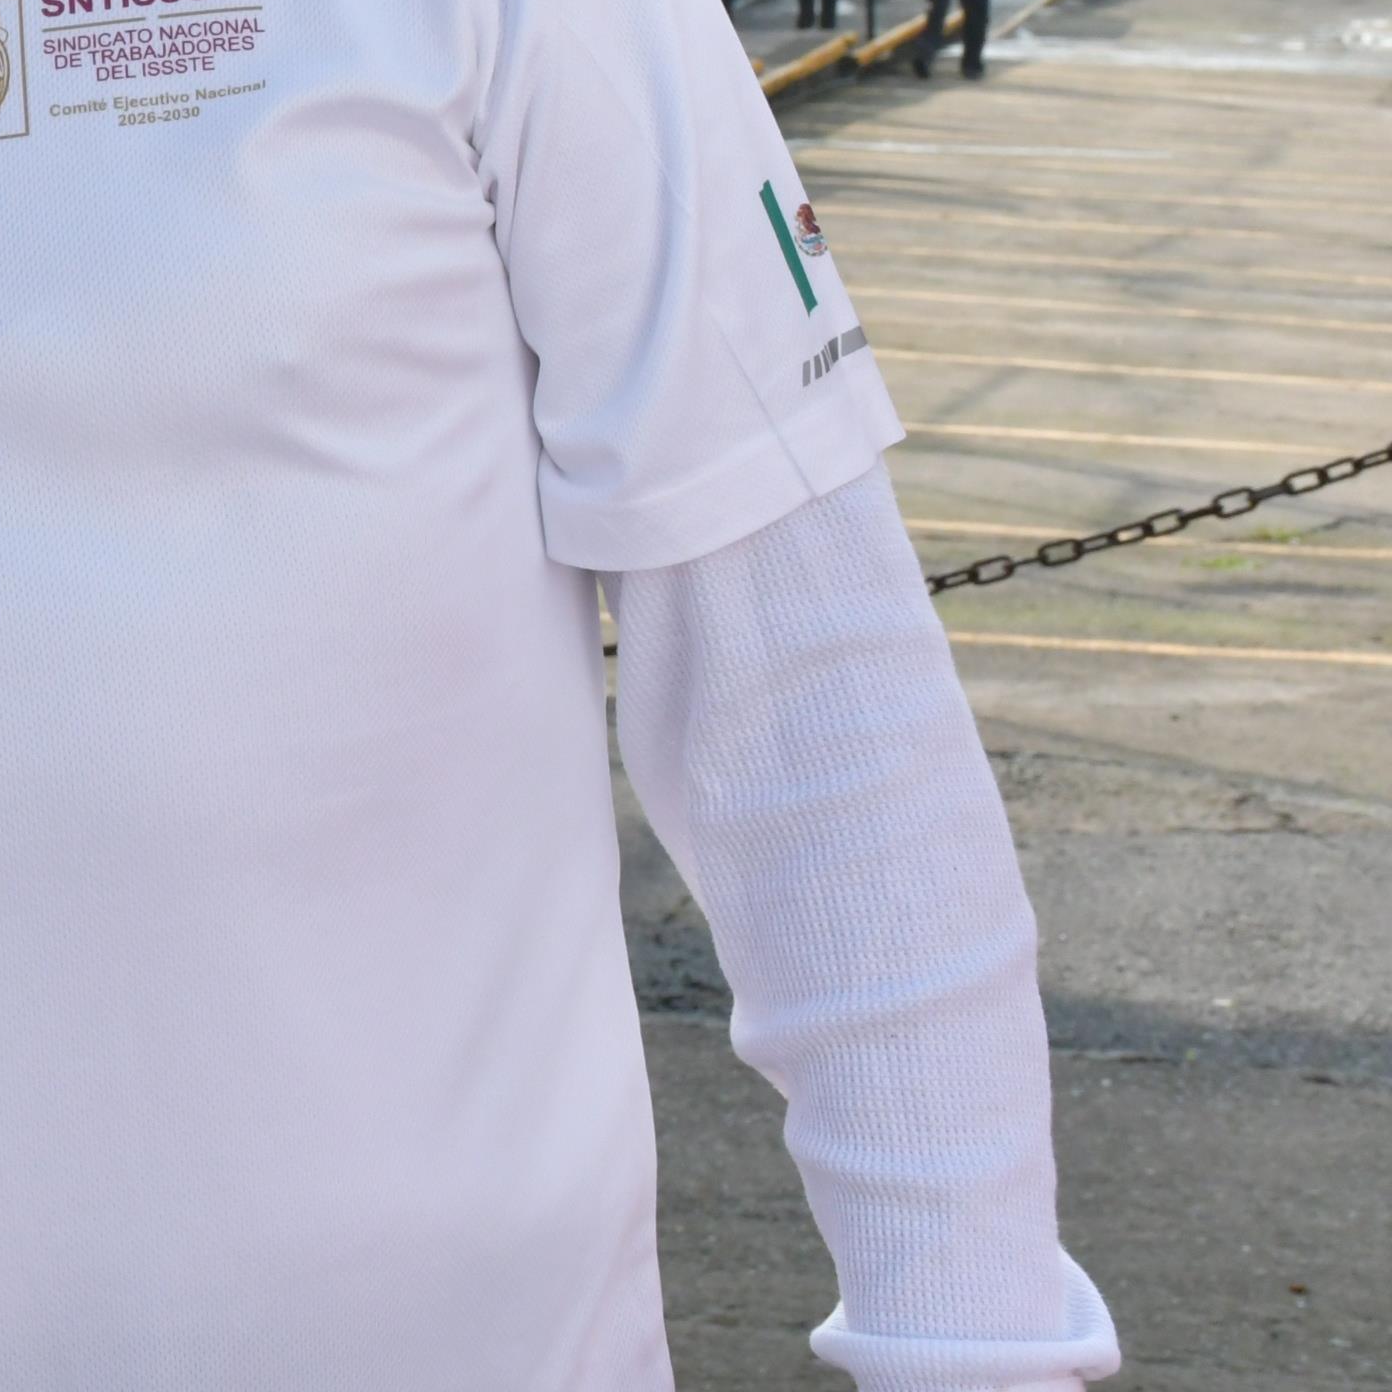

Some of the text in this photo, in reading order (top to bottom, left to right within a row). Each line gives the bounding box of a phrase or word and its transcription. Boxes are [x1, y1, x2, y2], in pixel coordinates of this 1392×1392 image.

[43, 17, 265, 55] SINDICATO NACIONAL
[54, 35, 255, 70] DE TRABAJADORES
[96, 56, 215, 82] DEL ISSSTE
[49, 80, 267, 118] Comité Ejecutivo Nacional
[118, 106, 201, 127] 2026-2030
